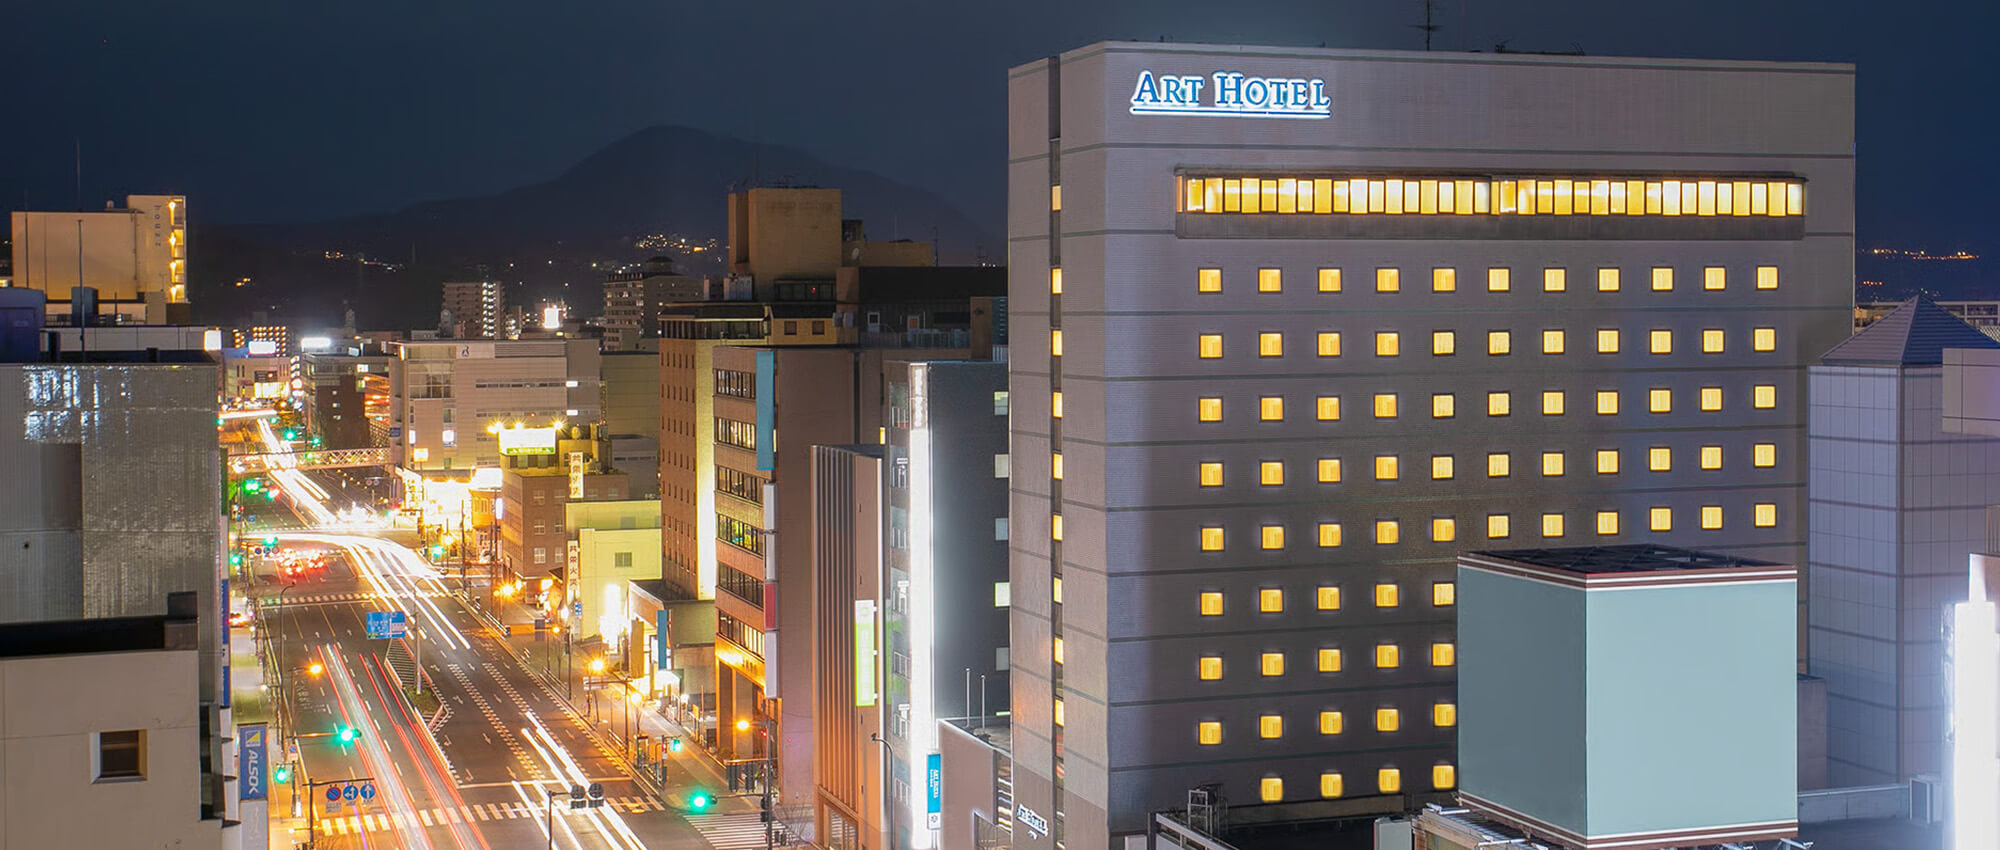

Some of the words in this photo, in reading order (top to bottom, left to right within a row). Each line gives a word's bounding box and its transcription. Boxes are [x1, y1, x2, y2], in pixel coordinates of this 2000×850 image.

[1132, 72, 1205, 104] ART
[1214, 73, 1331, 107] HOTEL
[248, 750, 259, 794] ALSOK
